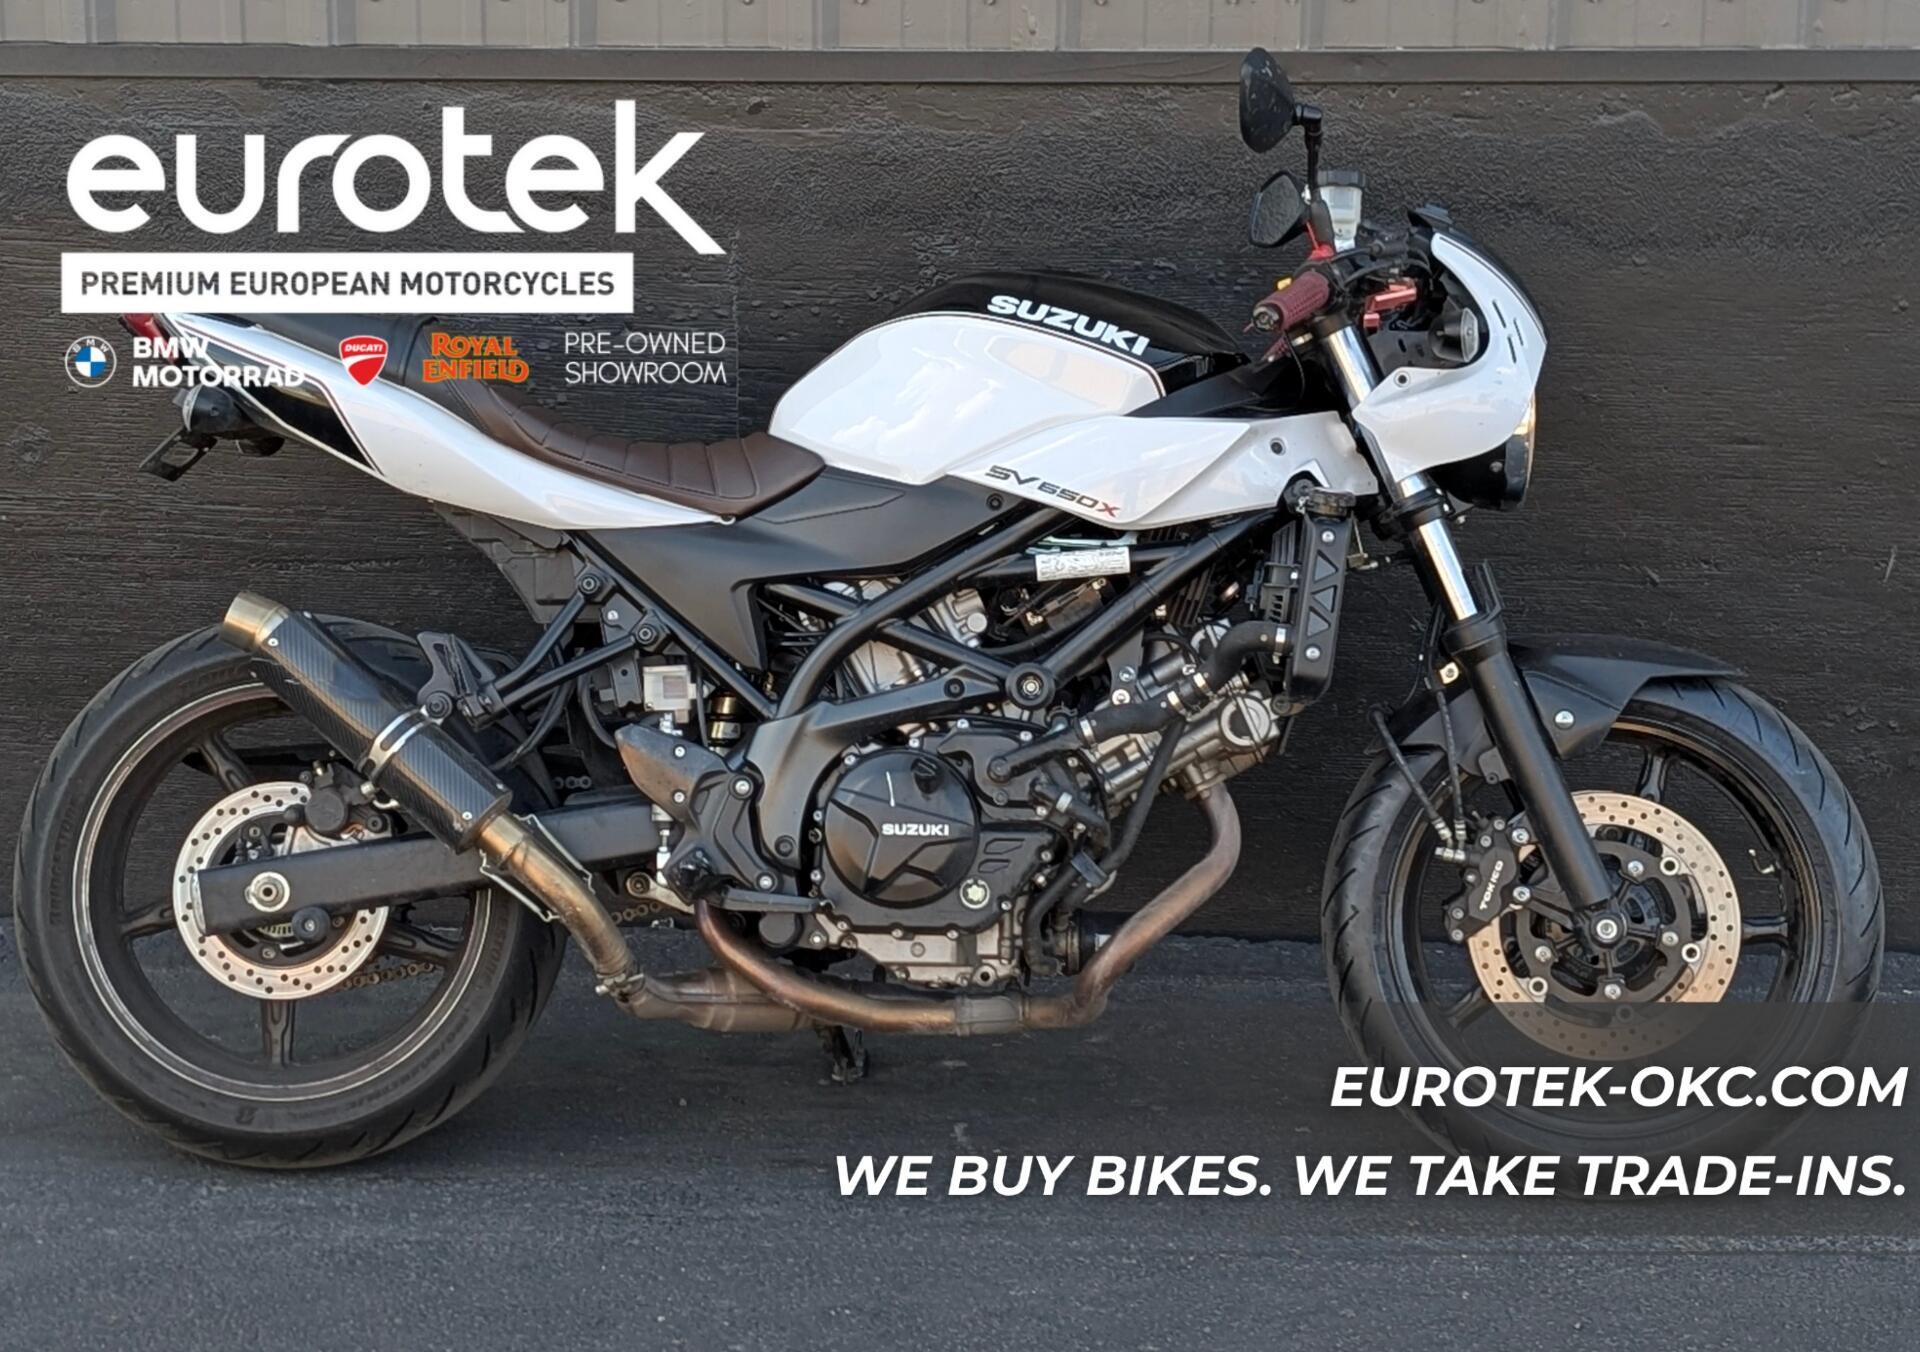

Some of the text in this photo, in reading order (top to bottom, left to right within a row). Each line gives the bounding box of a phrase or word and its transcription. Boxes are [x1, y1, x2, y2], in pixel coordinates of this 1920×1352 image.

[986, 294, 1150, 356] SUZUKI
[881, 822, 950, 838] SUZUKI
[1478, 859, 1505, 911] TOKICO
